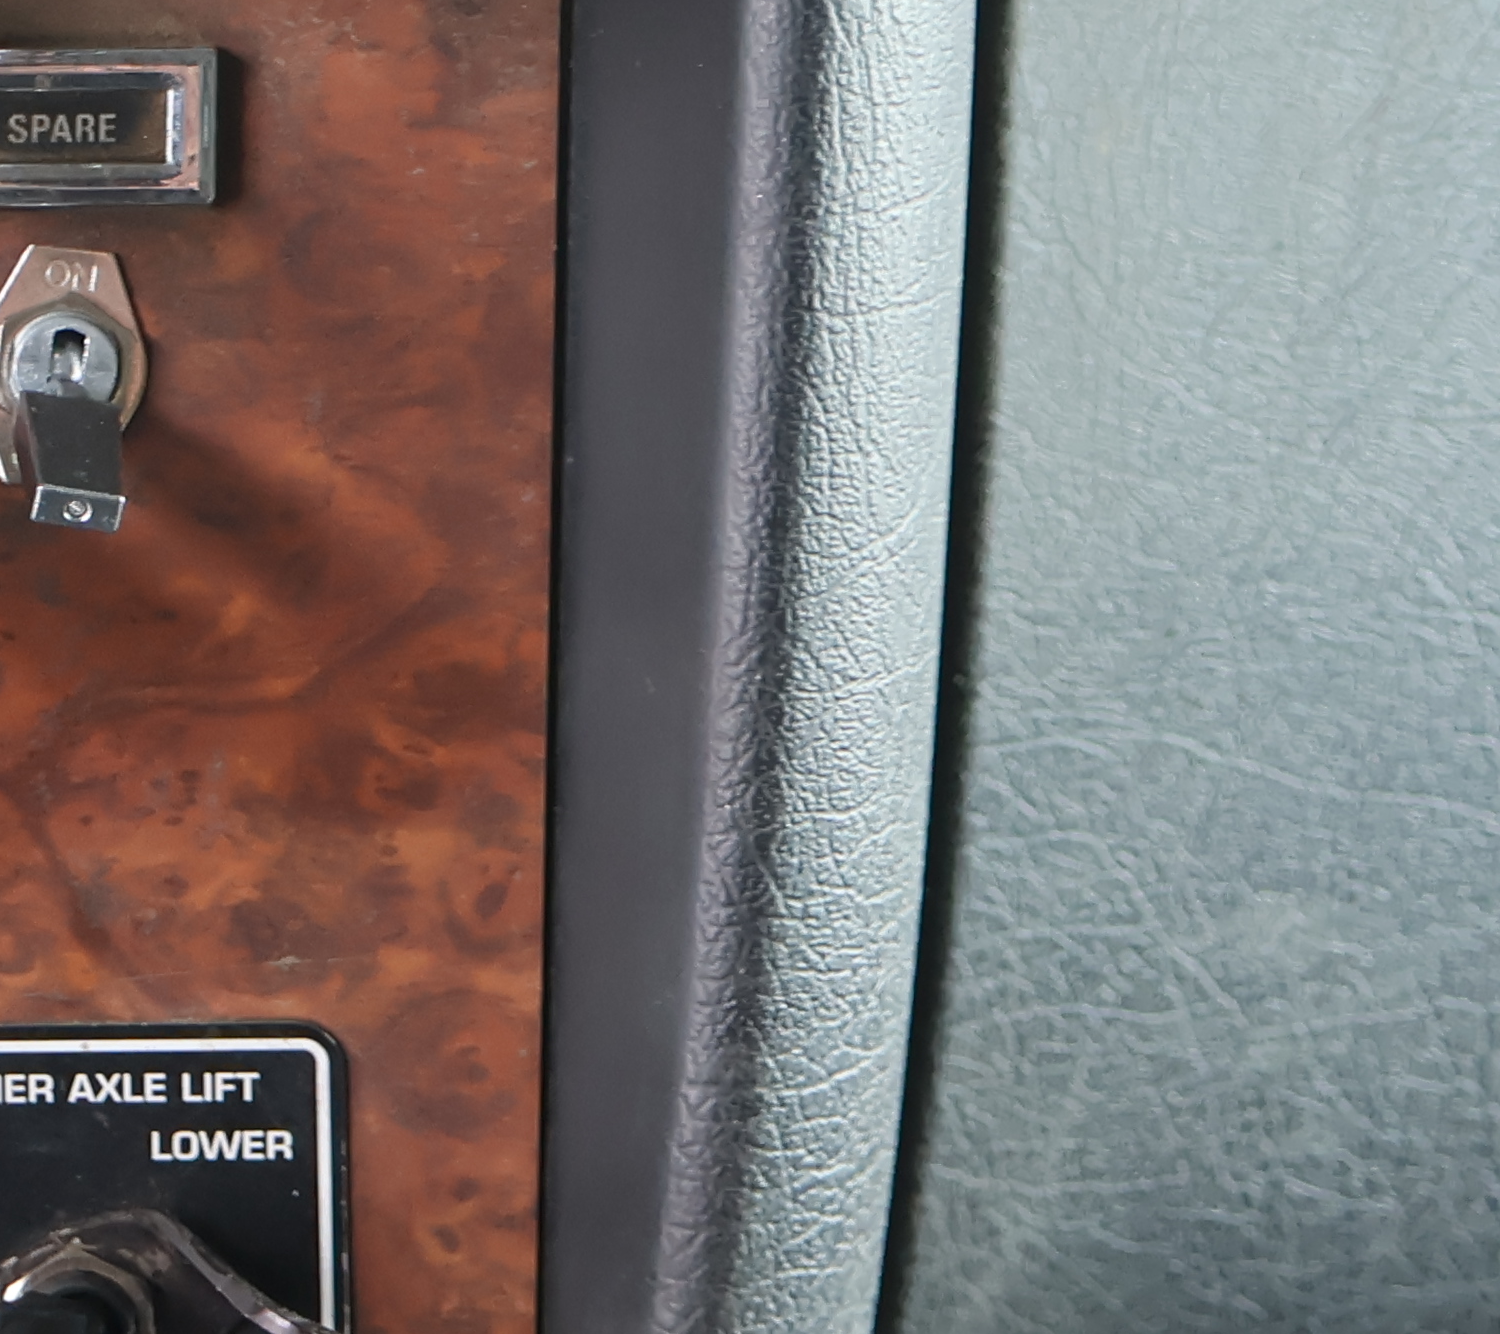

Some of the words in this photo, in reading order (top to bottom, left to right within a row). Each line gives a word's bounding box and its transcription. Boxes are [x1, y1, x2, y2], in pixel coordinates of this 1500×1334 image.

[7, 112, 117, 144] SPARE
[45, 259, 100, 293] ON
[66, 1072, 167, 1105] AXLE
[179, 1071, 261, 1104] LIFT
[149, 1128, 294, 1162] LOWER
